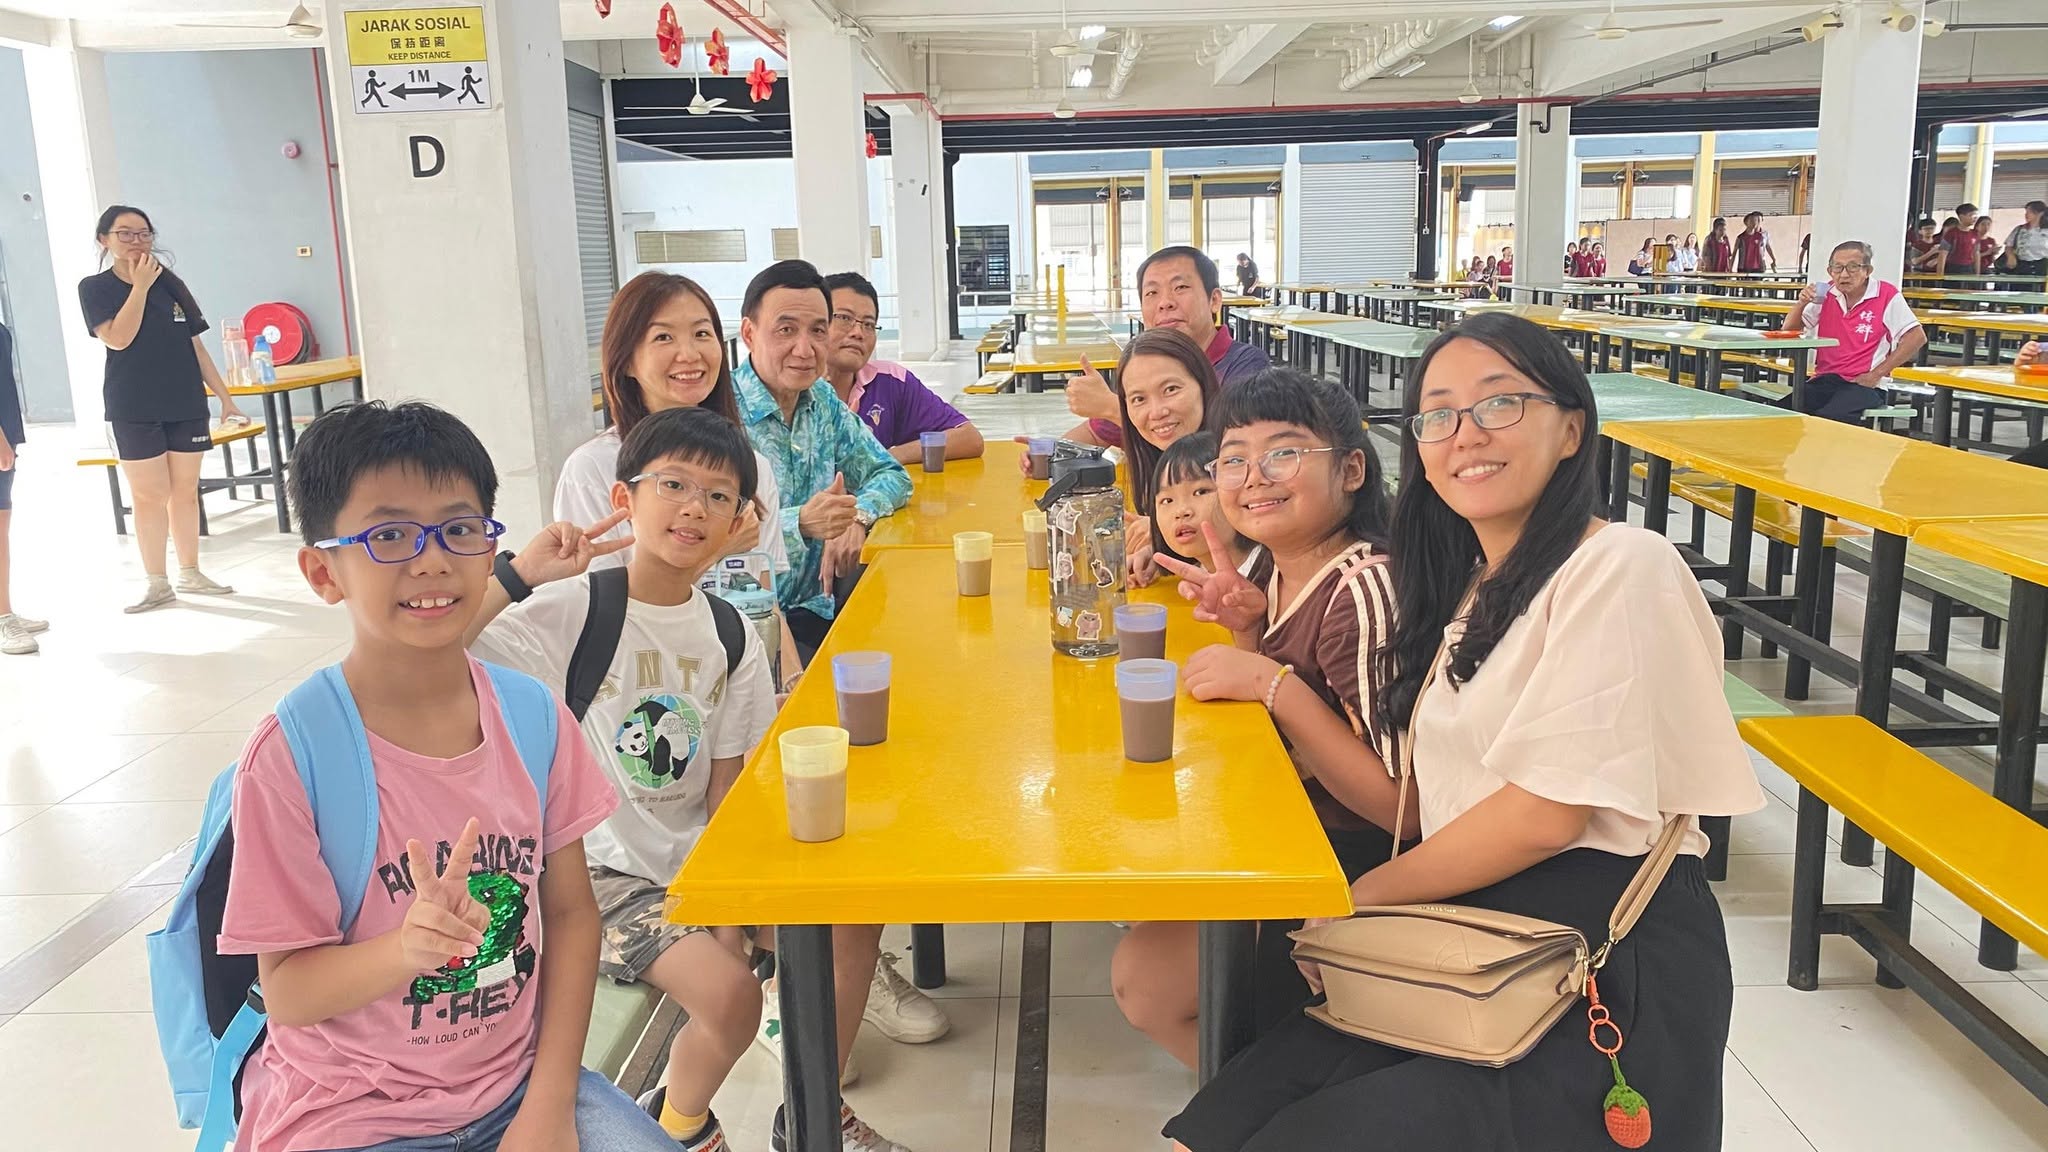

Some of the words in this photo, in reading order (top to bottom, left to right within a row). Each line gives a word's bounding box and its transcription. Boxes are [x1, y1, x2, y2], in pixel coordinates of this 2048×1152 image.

[361, 18, 411, 33] JARAK
[415, 16, 471, 31] SOSIAL
[390, 36, 445, 49] 保持距离
[388, 52, 408, 61] KEEP
[410, 51, 451, 60] DISTANCE
[408, 69, 430, 83] 1M
[409, 135, 445, 178] D
[435, 1032, 458, 1044] LOUD
[462, 1026, 480, 1039] CAN
